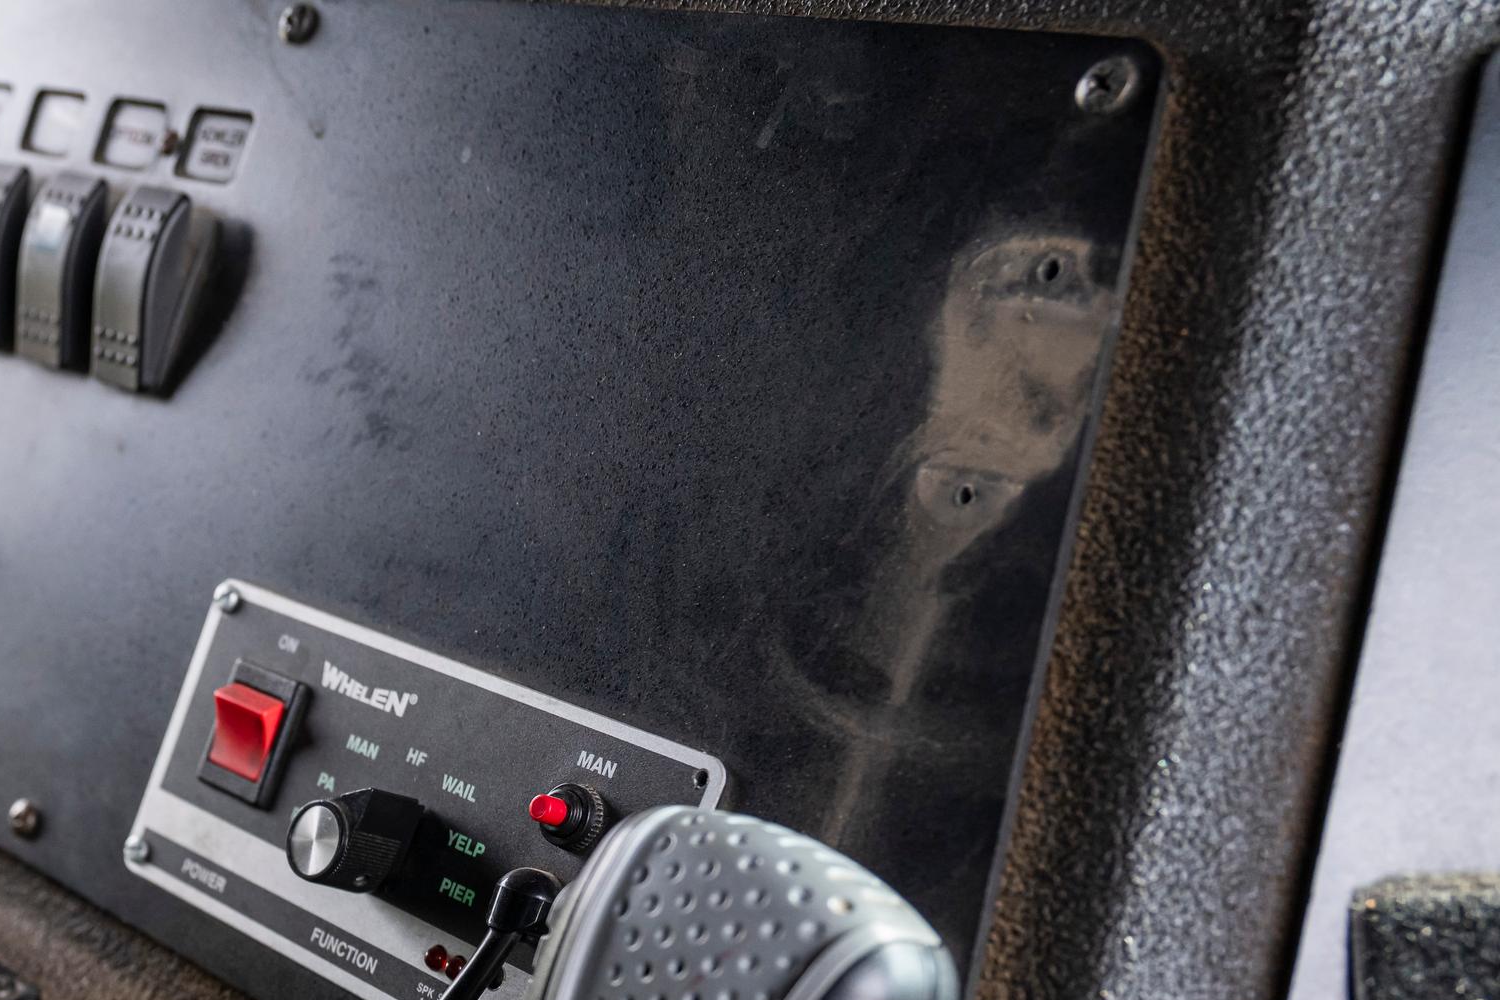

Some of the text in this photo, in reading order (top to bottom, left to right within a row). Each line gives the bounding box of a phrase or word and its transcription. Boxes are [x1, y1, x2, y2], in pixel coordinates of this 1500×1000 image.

[278, 634, 300, 654] ON
[346, 733, 380, 761] MAN
[405, 747, 428, 767] HF
[576, 750, 618, 779] MAN
[316, 771, 336, 793] PA
[441, 773, 477, 803] WAIL
[448, 829, 486, 858] YELP
[180, 858, 228, 894] POWER
[438, 877, 476, 908] PIER
[310, 927, 379, 975] FUNCTION
[416, 982, 436, 1000] SPK
